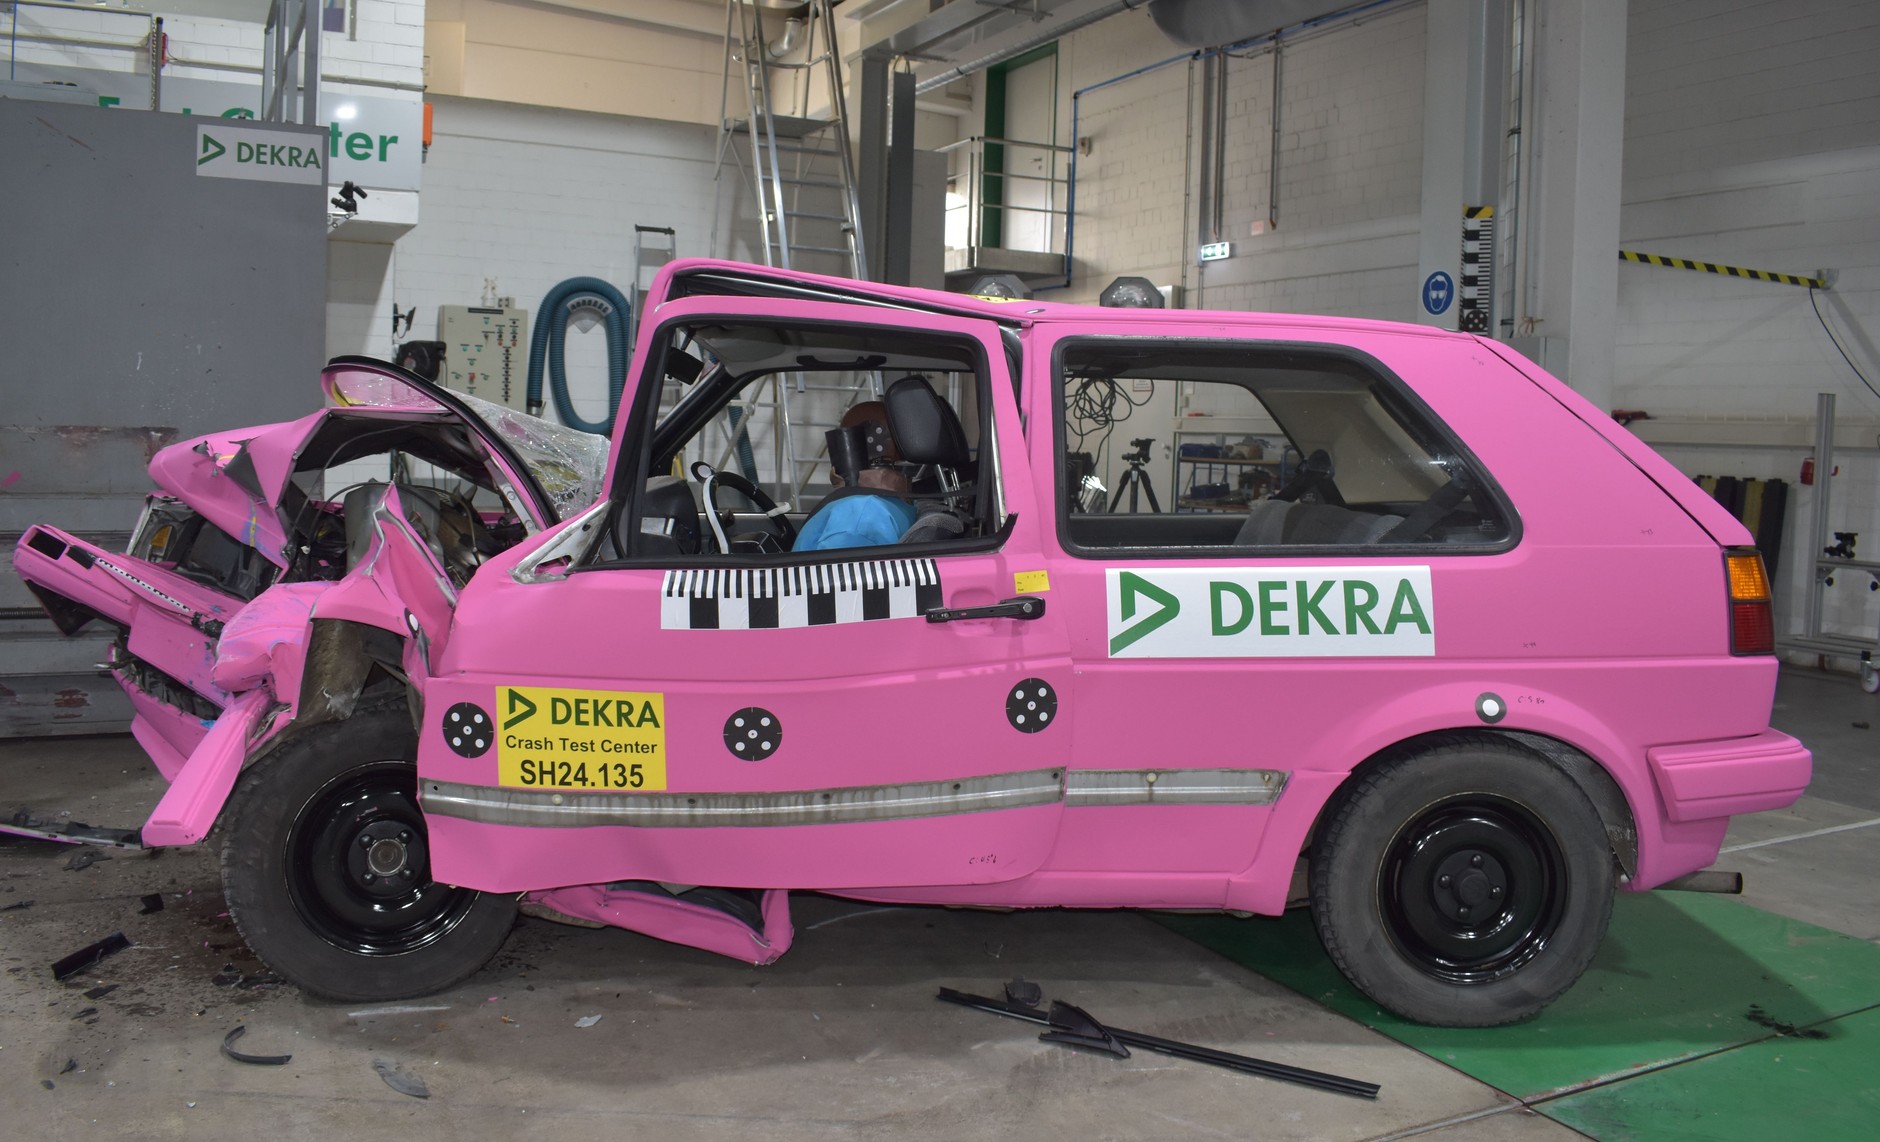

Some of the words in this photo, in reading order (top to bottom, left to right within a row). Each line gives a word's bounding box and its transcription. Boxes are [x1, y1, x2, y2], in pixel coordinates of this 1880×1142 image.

[236, 141, 321, 169] DEKRA
[329, 121, 399, 162] ter
[1209, 578, 1432, 636] DEKRA
[551, 697, 661, 728] DEKRA
[505, 735, 553, 751] Crash
[558, 737, 596, 753] Test
[600, 739, 658, 754] Center
[520, 759, 645, 788] SH24.135
